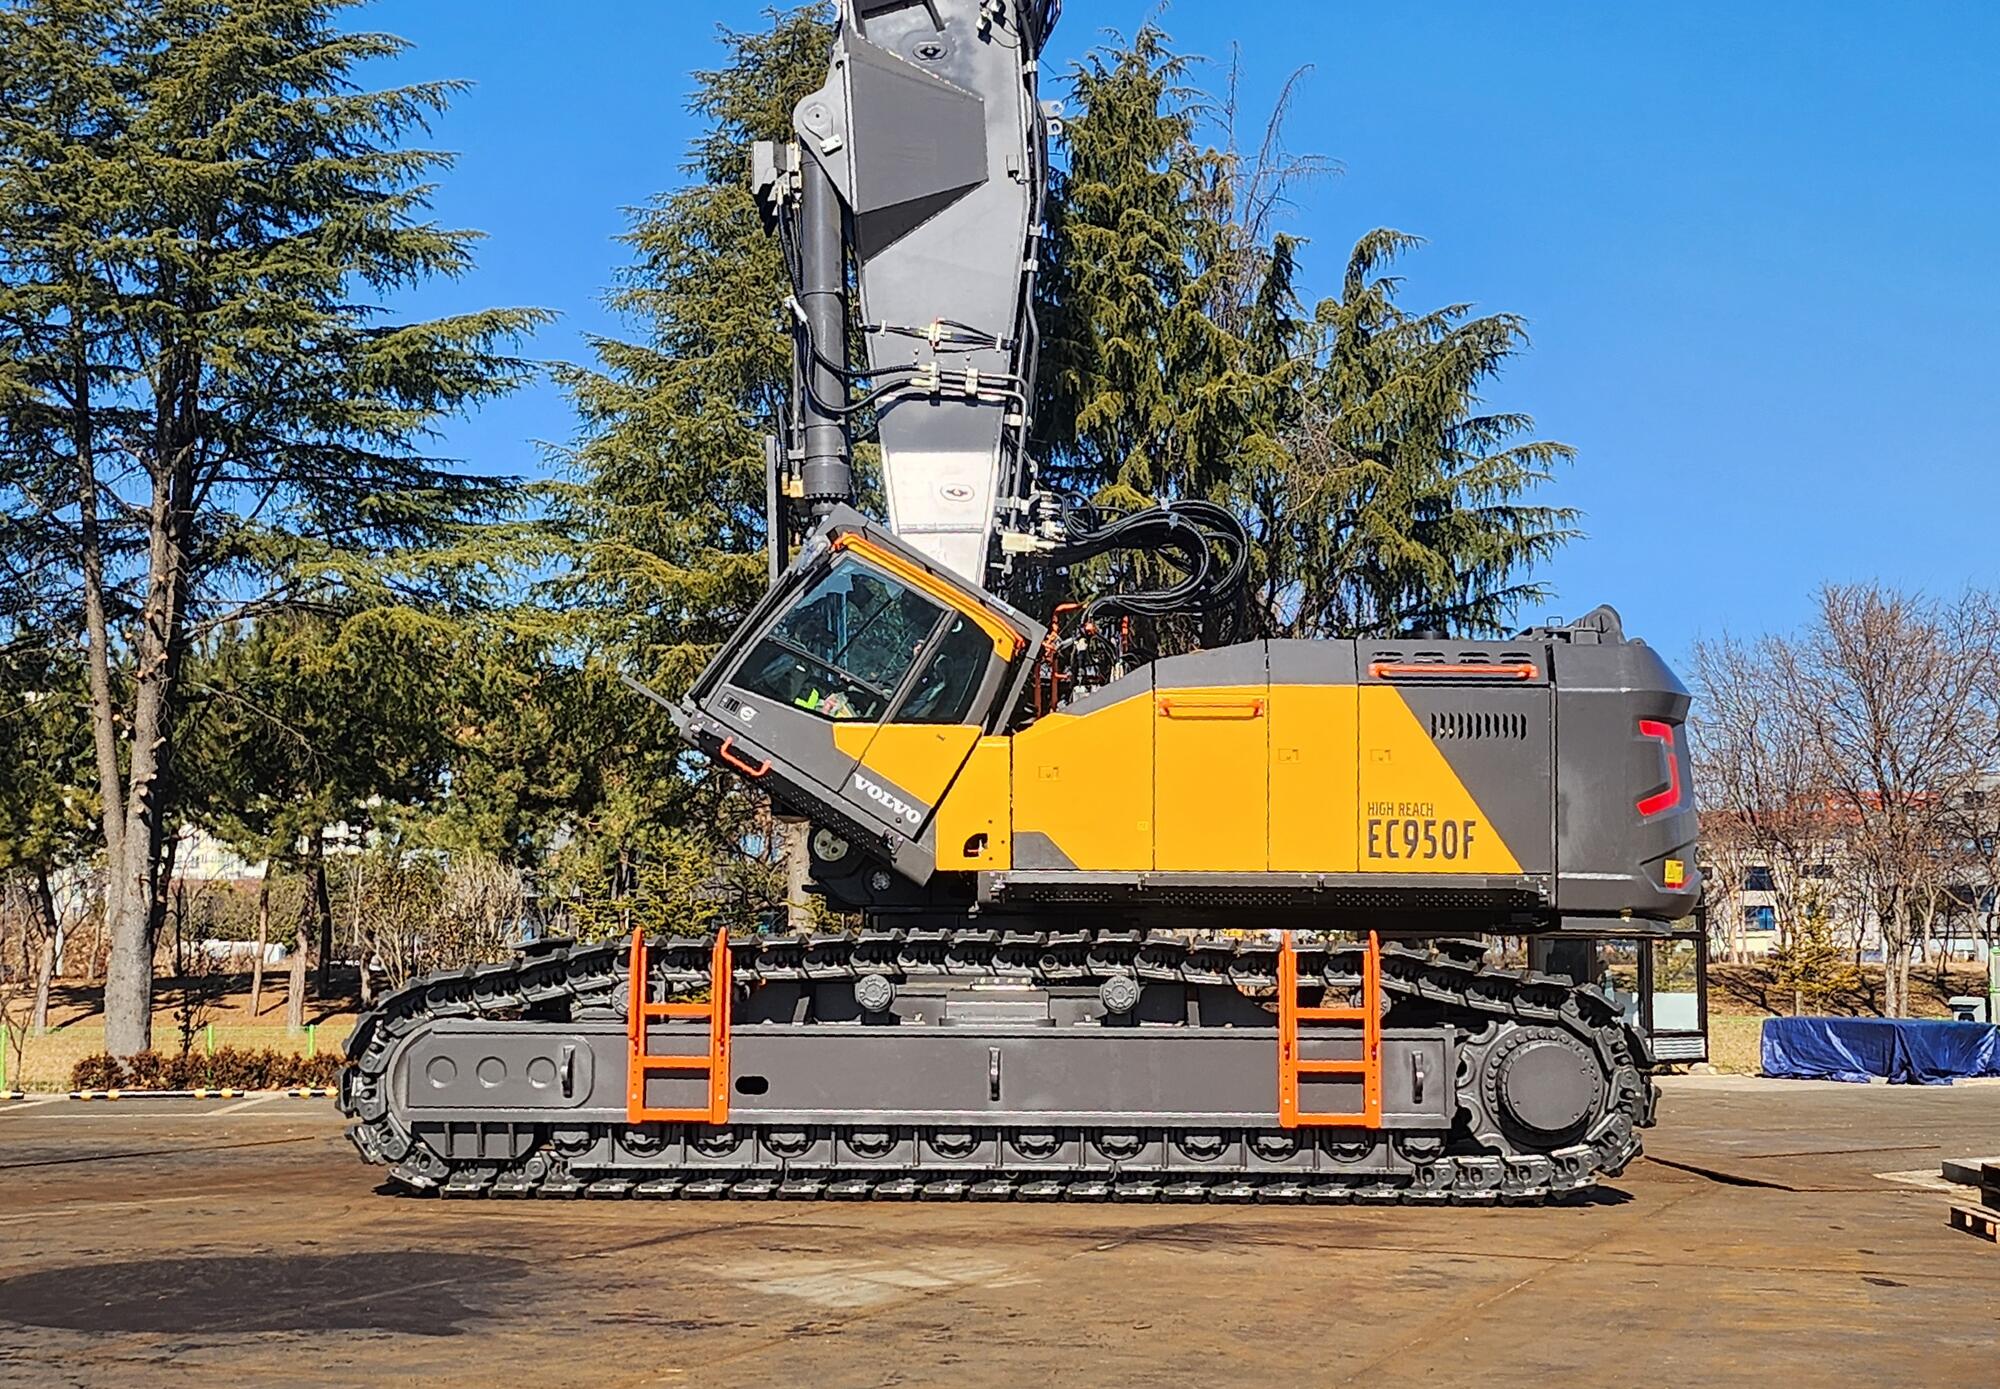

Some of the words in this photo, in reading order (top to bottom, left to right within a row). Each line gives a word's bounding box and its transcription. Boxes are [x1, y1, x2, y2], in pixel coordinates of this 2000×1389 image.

[853, 772, 921, 823] VOLVO
[1367, 801, 1394, 816] HIGH
[1398, 802, 1434, 817] REACH
[1368, 819, 1476, 860] EC950F
